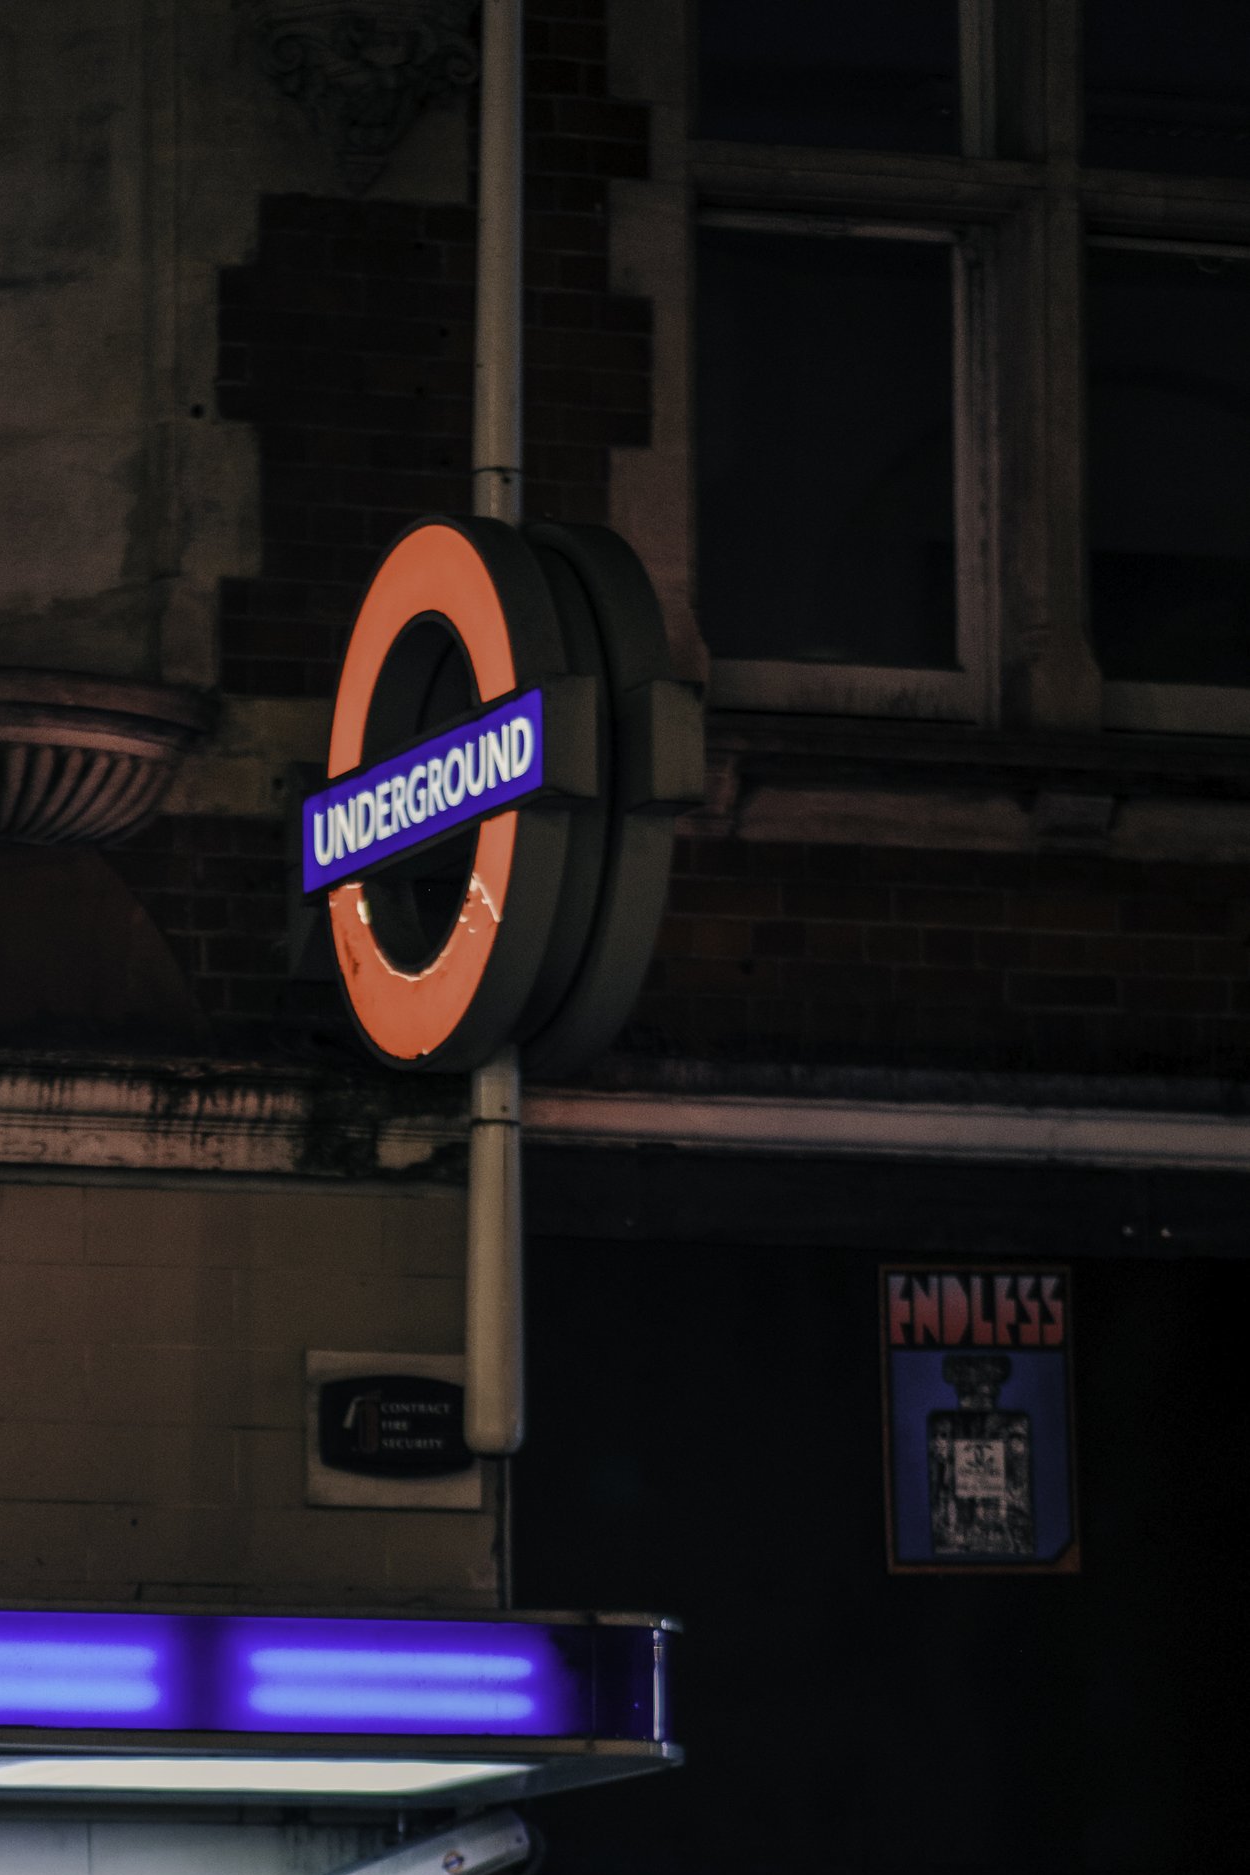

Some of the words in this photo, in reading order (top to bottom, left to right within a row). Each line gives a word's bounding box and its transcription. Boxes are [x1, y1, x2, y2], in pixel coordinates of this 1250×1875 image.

[313, 716, 534, 866] UNDERGROUND
[887, 1273, 1064, 1345] ENDLESS
[380, 1402, 450, 1415] CONTRACT
[381, 1420, 410, 1432] FIRE
[381, 1438, 444, 1450] SECURITY
